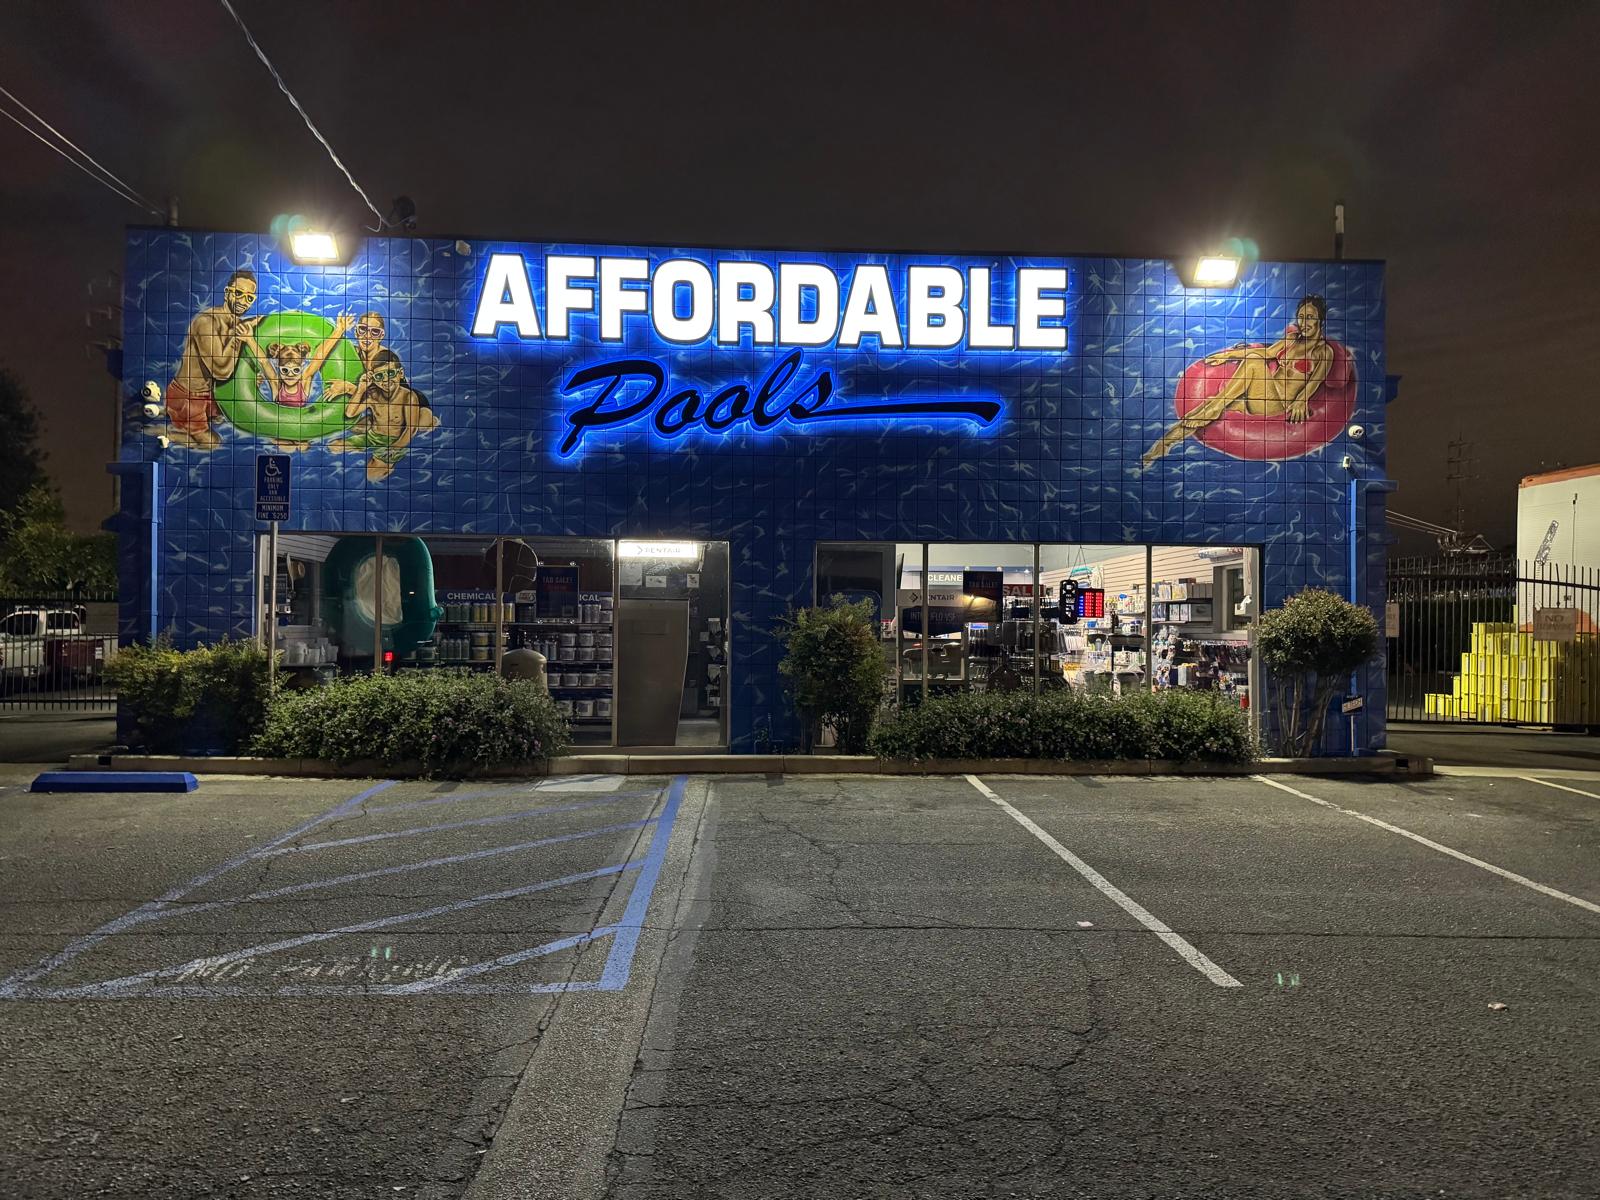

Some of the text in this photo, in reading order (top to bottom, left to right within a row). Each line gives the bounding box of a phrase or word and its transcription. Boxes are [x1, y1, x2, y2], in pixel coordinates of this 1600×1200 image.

[471, 252, 1068, 350] AFFORDABLE
[560, 349, 1003, 457] Pools
[258, 511, 269, 519] FINE
[928, 574, 962, 582] CLEANE
